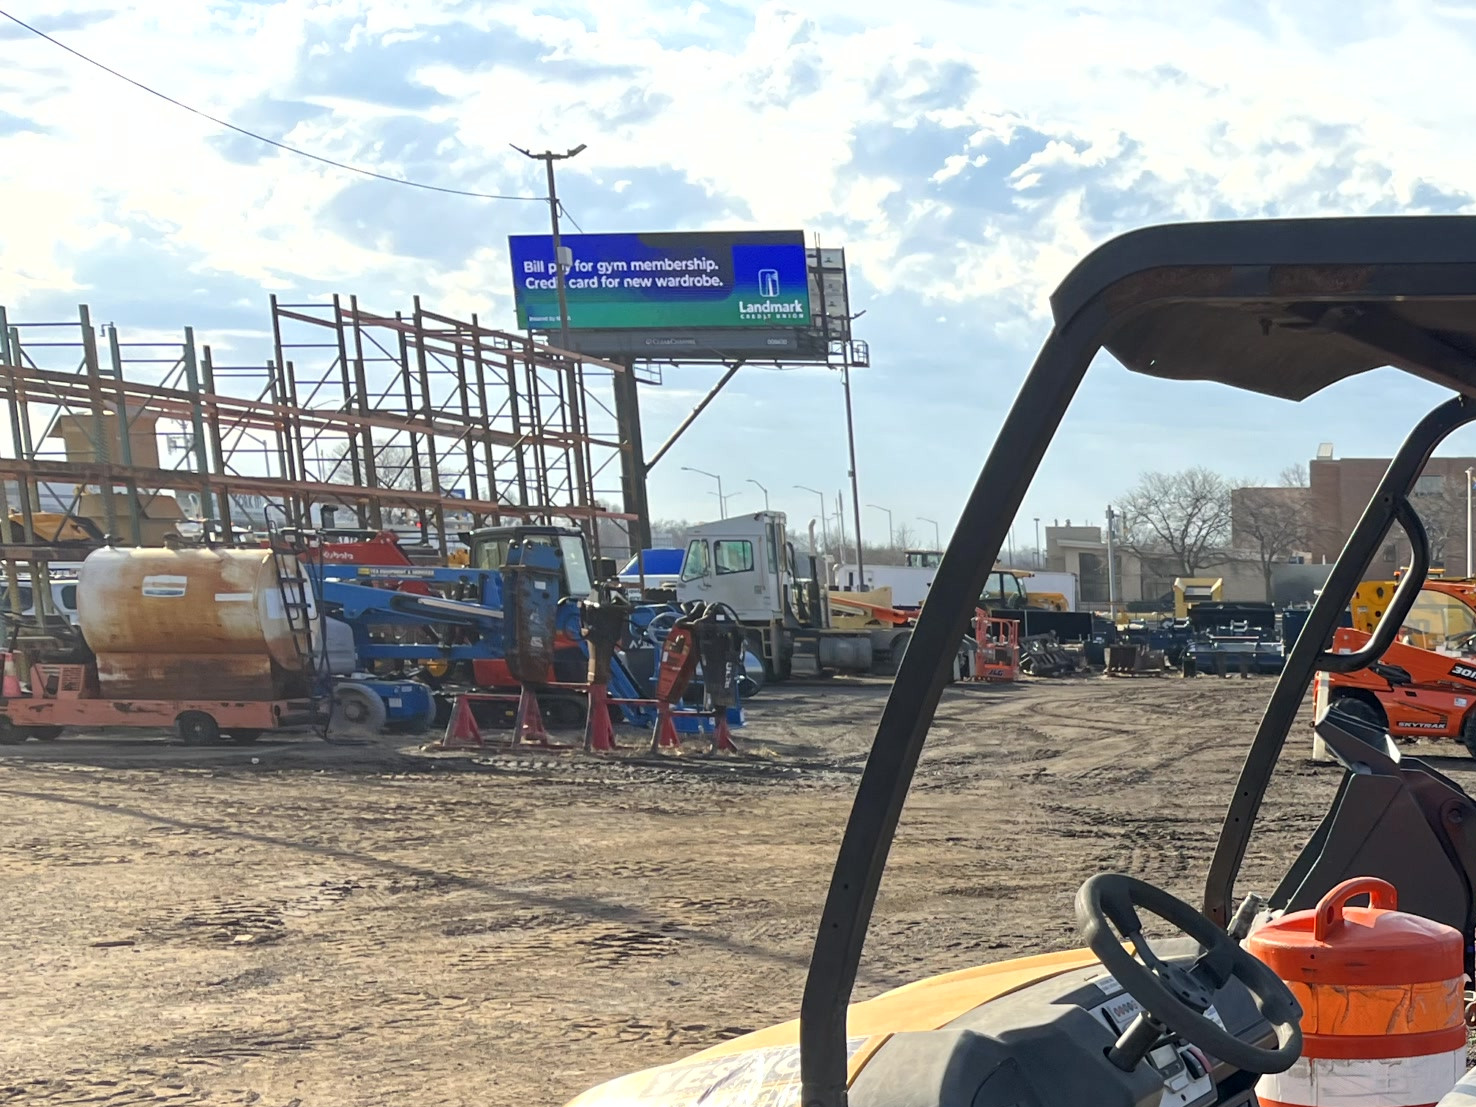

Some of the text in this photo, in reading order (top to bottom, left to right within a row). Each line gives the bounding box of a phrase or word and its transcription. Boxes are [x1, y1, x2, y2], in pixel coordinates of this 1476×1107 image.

[523, 257, 719, 275] Bill py for gym membership.
[568, 275, 599, 289] card
[600, 275, 620, 288] for
[623, 277, 653, 288] new
[655, 274, 724, 287] wardrobe.
[738, 300, 803, 313] Landmark
[988, 669, 1003, 677] JLG
[1398, 721, 1447, 729] SKYTRAK
